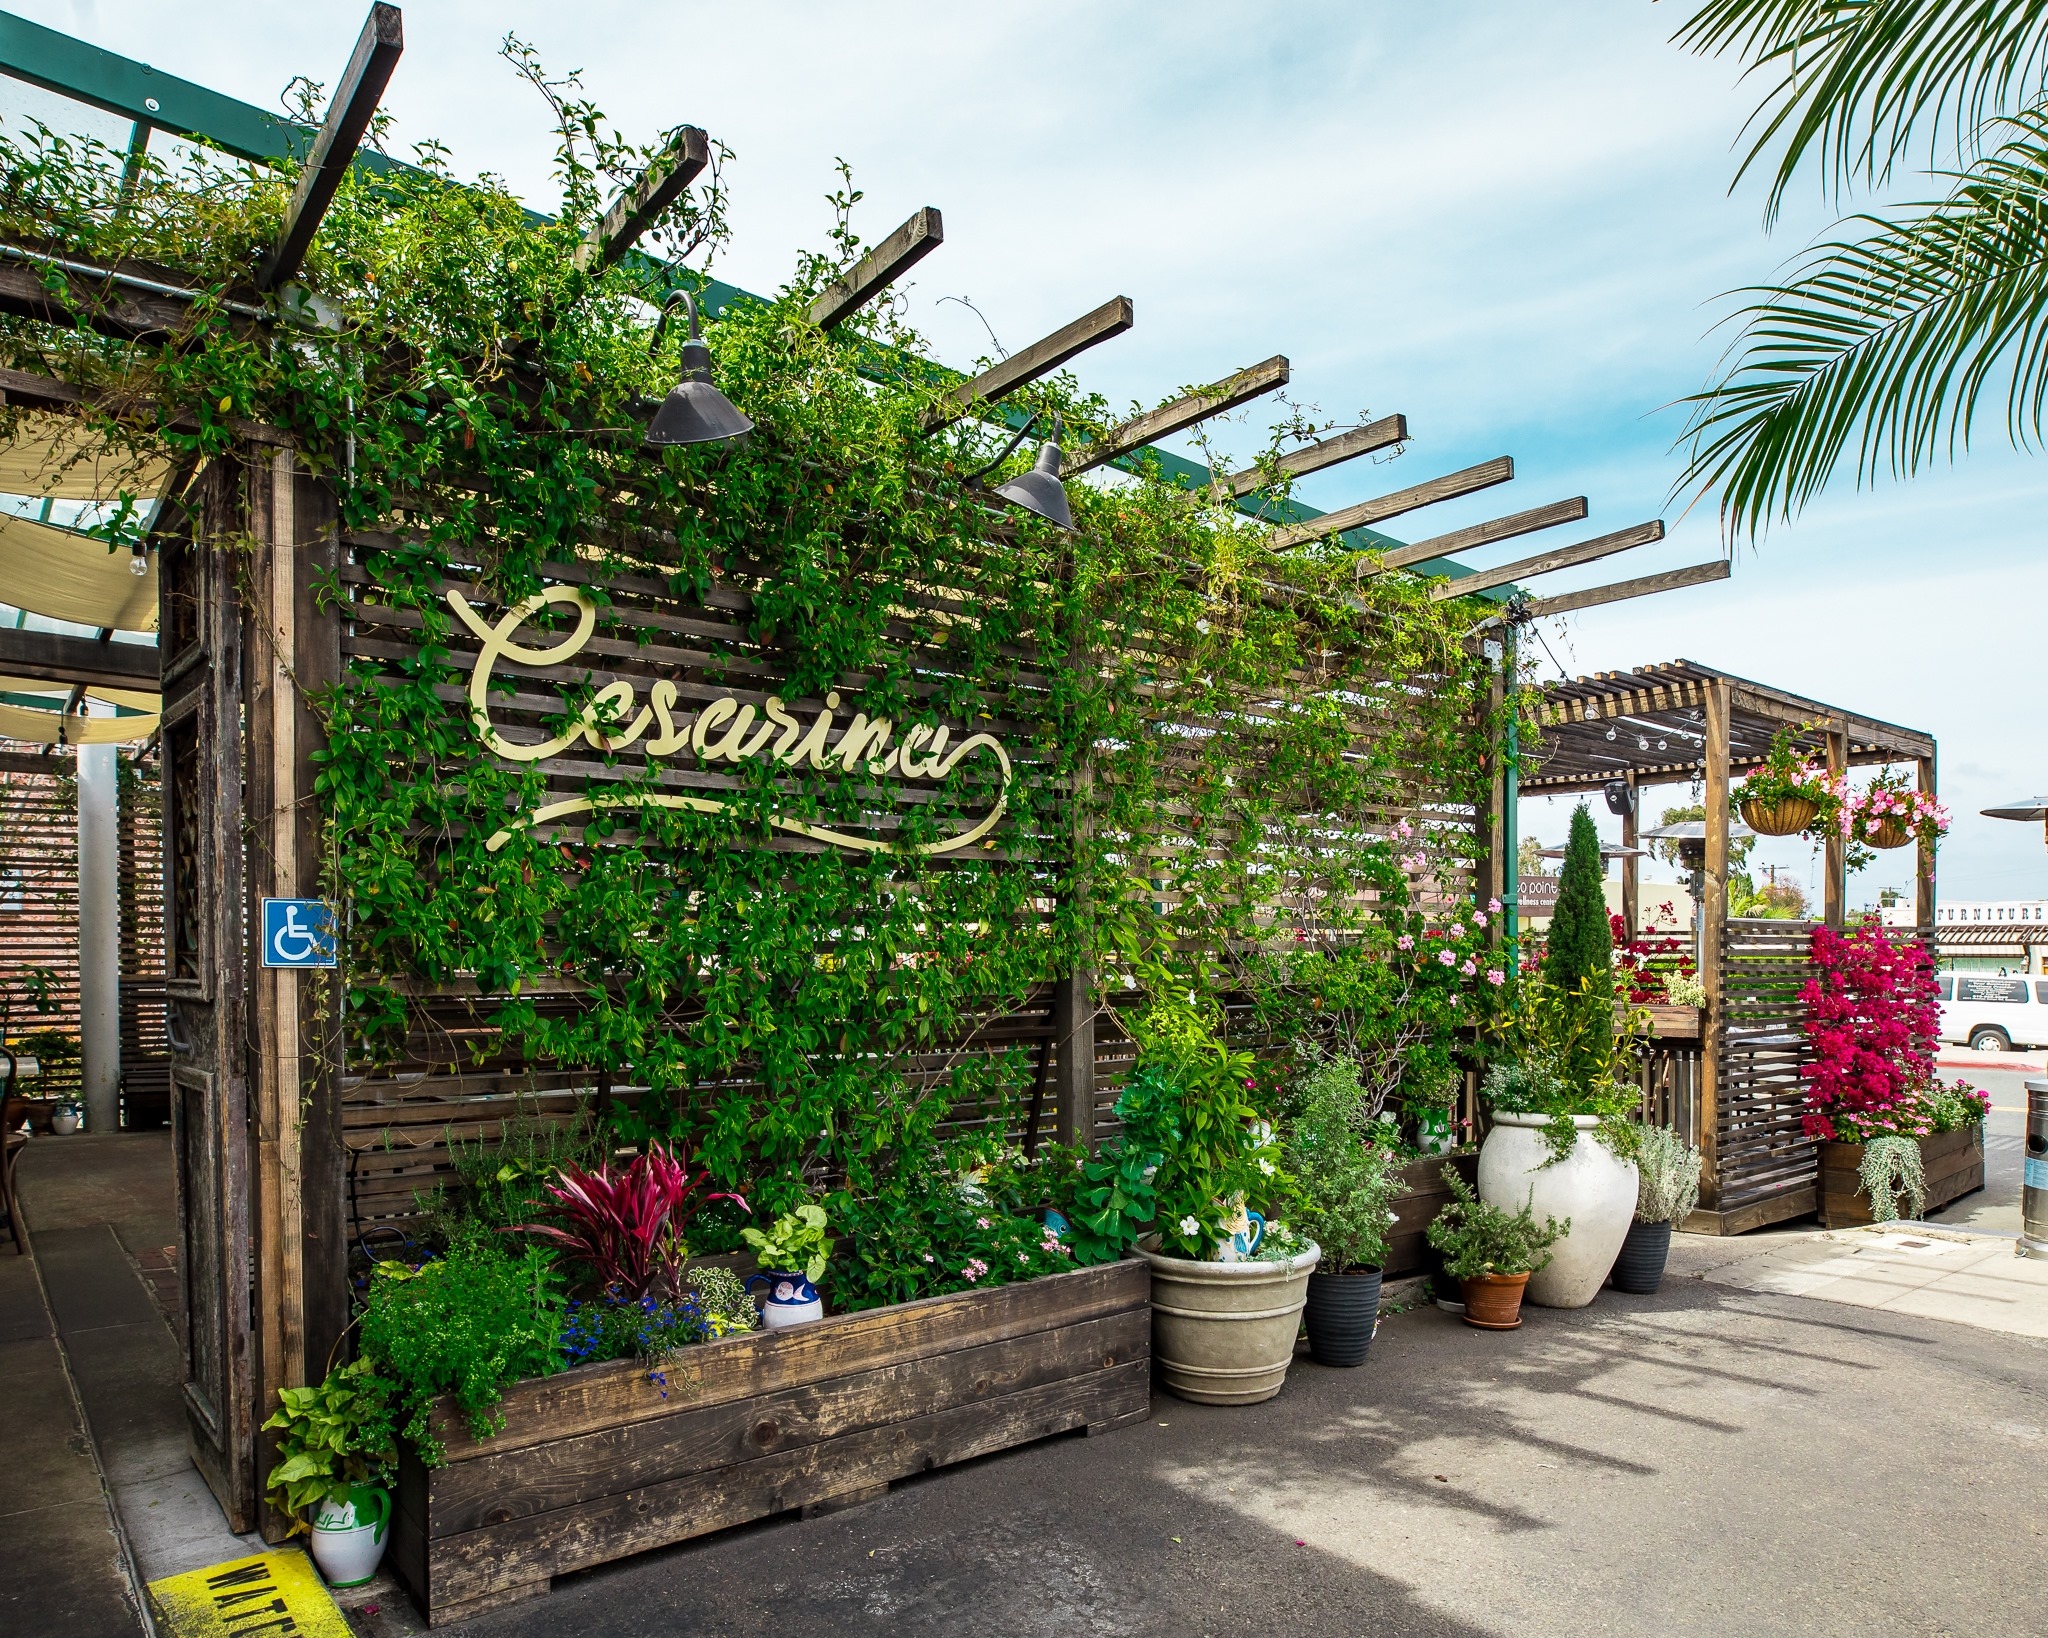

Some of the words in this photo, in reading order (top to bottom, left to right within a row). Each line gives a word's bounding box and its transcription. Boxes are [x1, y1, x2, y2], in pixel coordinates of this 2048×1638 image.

[446, 586, 1012, 853] Cesarina
[1937, 907, 2042, 921] FURNITURE
[206, 1562, 304, 1638] WATC
